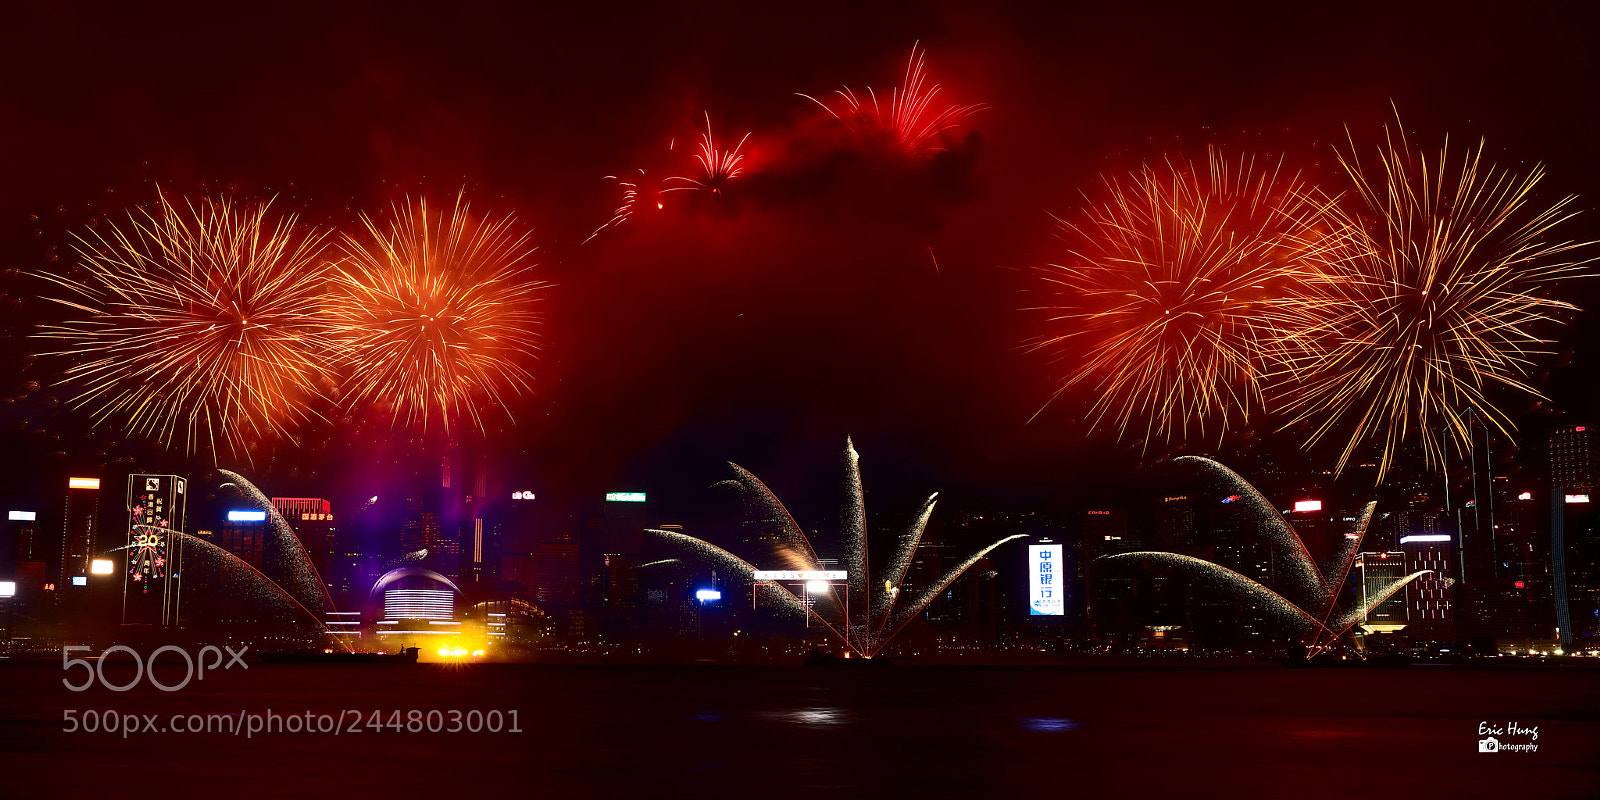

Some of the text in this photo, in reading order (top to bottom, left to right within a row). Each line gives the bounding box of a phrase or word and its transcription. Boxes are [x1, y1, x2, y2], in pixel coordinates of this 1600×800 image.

[139, 535, 158, 546] 20
[1039, 550, 1053, 598] 中原银行
